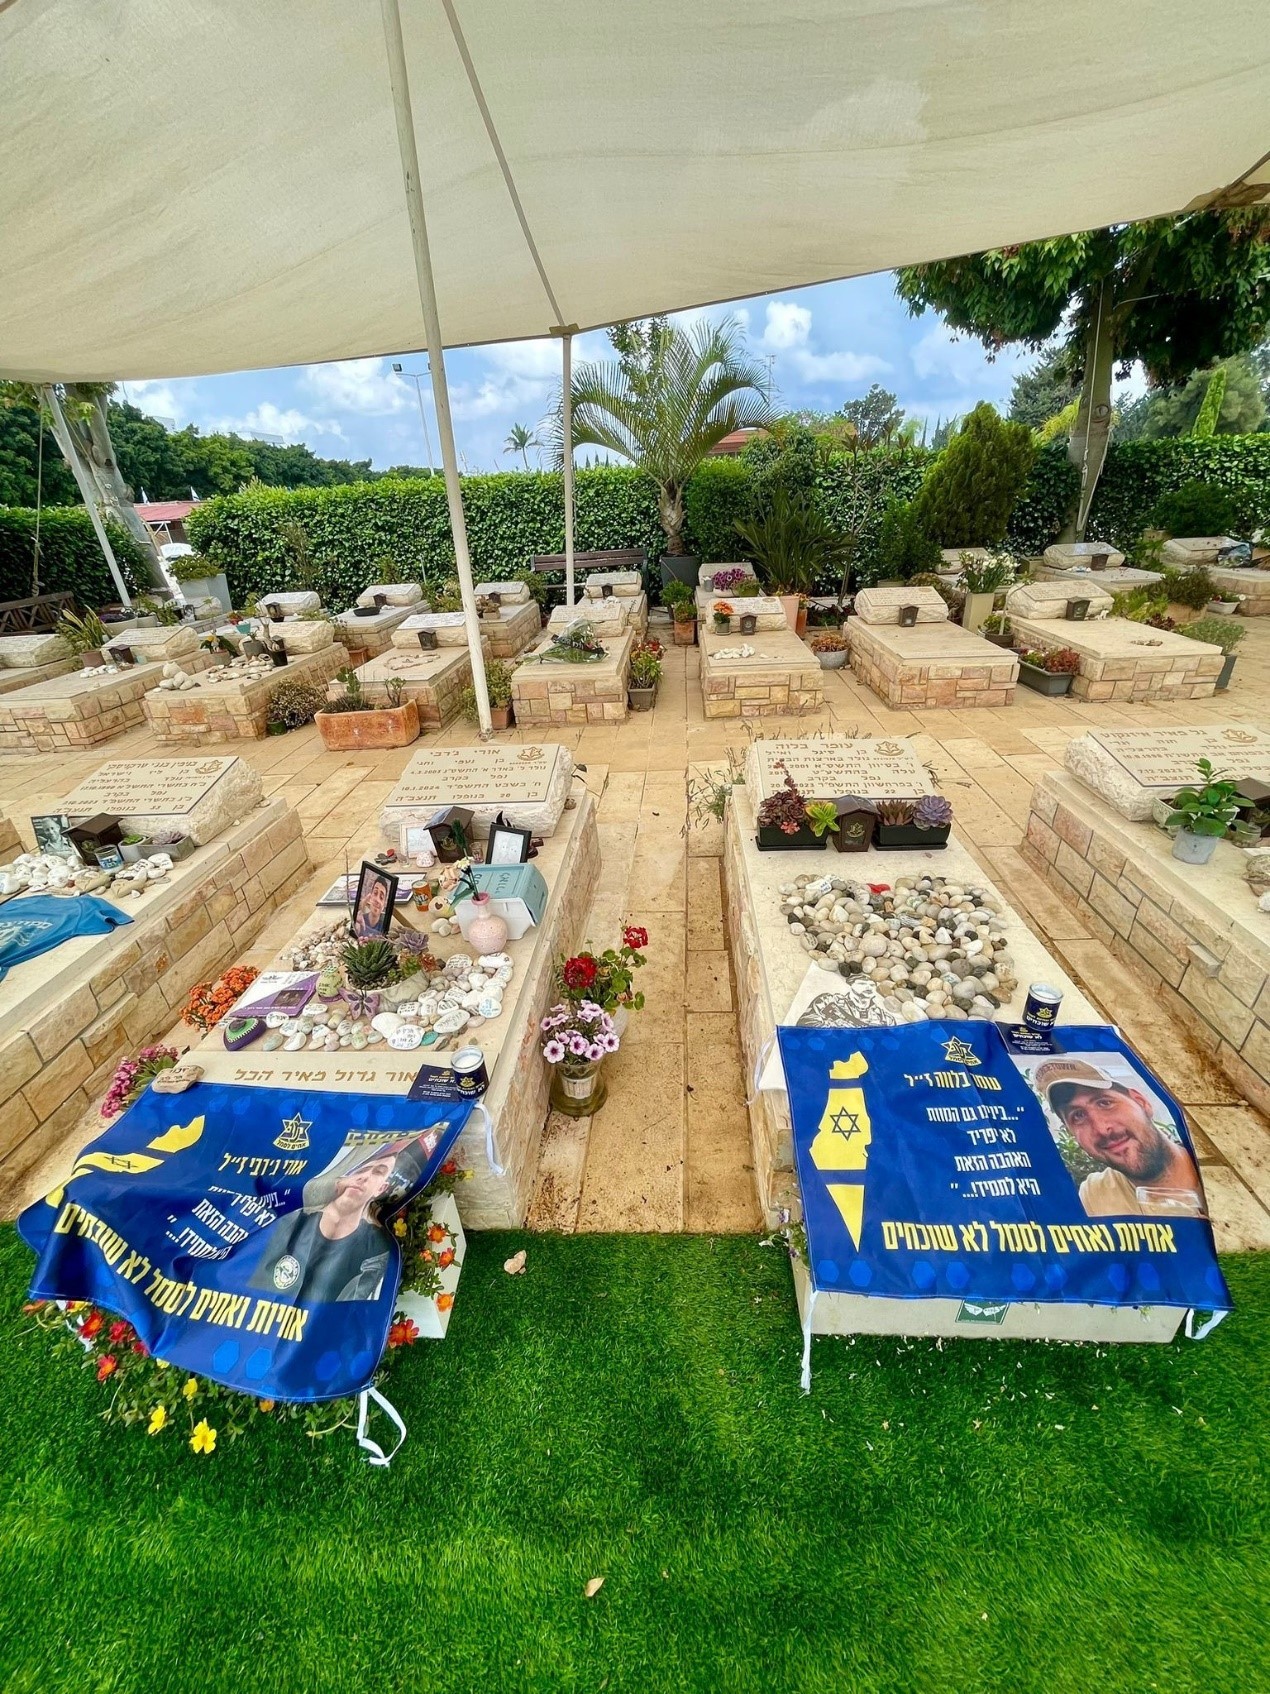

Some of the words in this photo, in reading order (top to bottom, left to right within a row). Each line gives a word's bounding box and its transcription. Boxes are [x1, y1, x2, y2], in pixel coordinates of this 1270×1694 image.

[234, 1068, 274, 1082] הכל
[281, 1070, 327, 1082] מאיר
[335, 1069, 377, 1082] גדול
[385, 1070, 418, 1082] אור
[926, 1107, 960, 1122] המוות
[960, 1107, 978, 1122] גם
[966, 1127, 999, 1146] יפריד
[999, 1127, 1017, 1144] לא
[282, 1159, 308, 1175] אורי
[953, 1155, 989, 1172] הזאת
[988, 1151, 1032, 1169] האהבה
[1016, 1178, 1041, 1196] היא
[191, 1198, 226, 1231] הזאת
[254, 1209, 277, 1228] לא
[54, 1202, 129, 1266] שוכחים
[881, 1220, 960, 1252] שוכחים
[959, 1220, 989, 1252] לא
[989, 1220, 1047, 1254] לסמל
[1047, 1223, 1115, 1254] ואחים
[1112, 1222, 1177, 1254] אחיות
[116, 1249, 152, 1285] לא
[146, 1267, 197, 1317] לסמל
[189, 1288, 252, 1329] ואחים
[245, 1299, 309, 1342] אחיות
